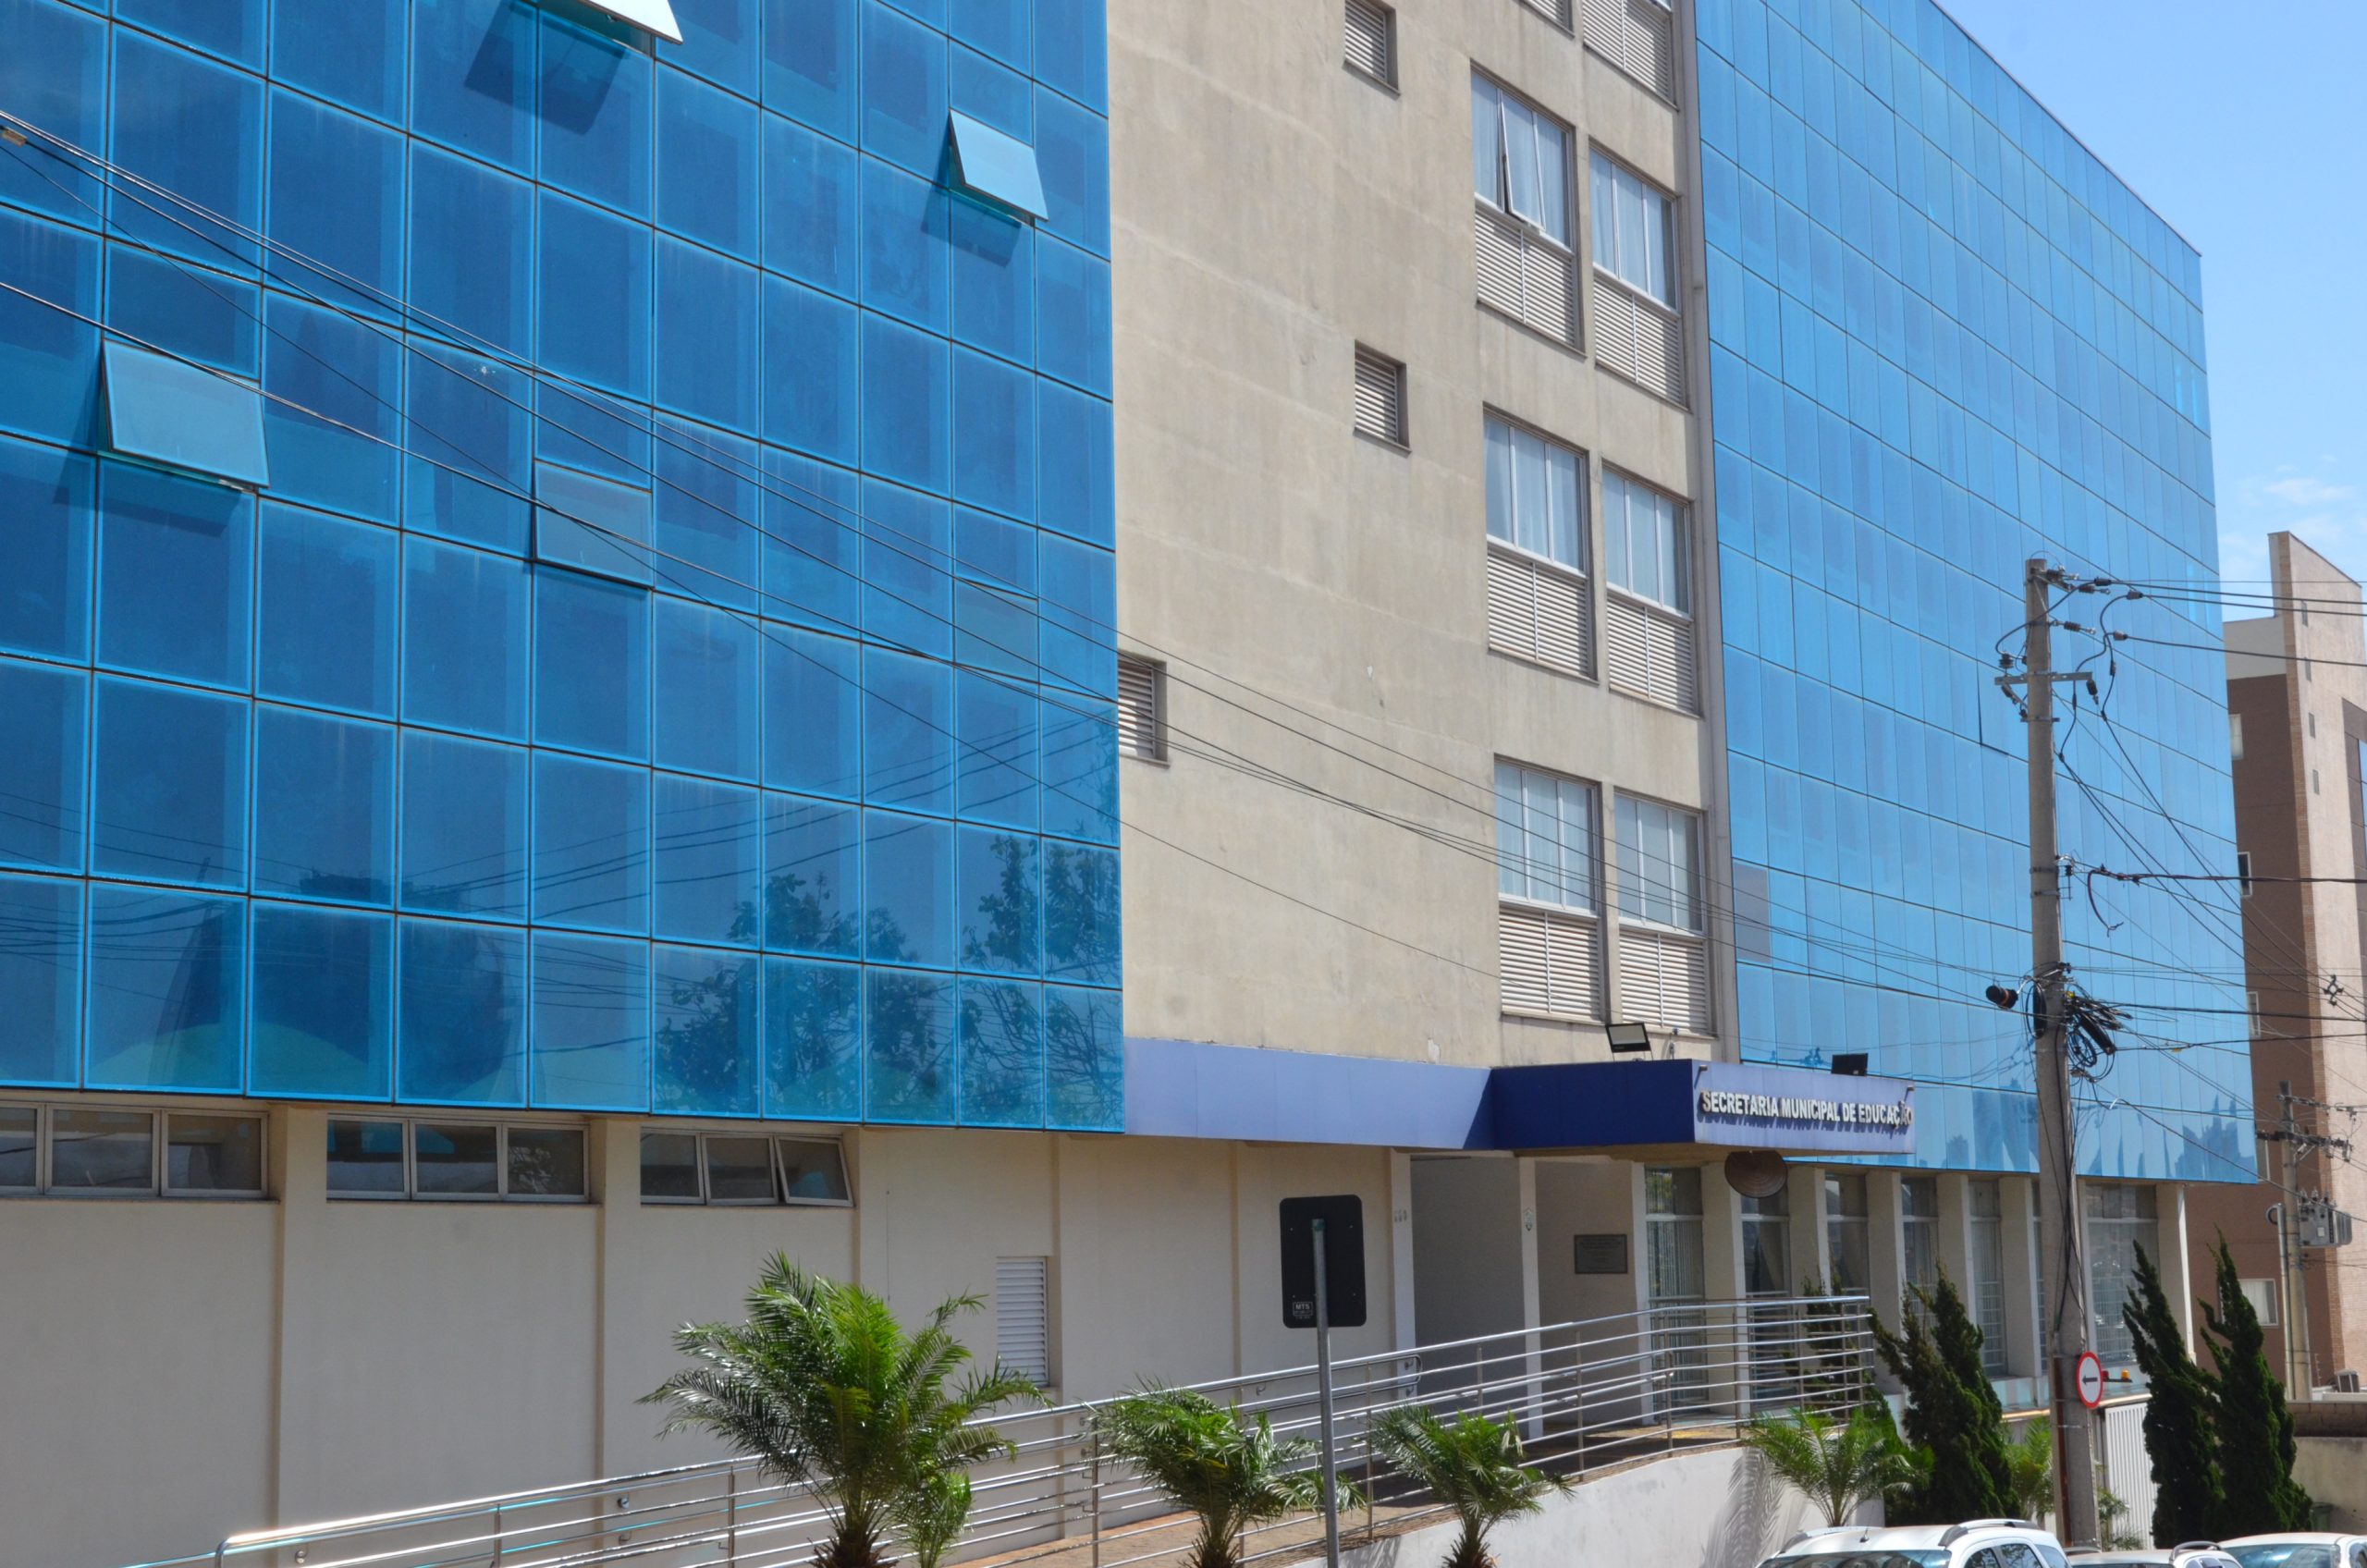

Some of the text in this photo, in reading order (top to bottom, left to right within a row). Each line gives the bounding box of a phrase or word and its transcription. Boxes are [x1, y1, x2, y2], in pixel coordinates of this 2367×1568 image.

[1701, 1091, 1779, 1118] SECRETARIA
[1781, 1097, 1840, 1121] MUNICIPAL
[1842, 1103, 1857, 1122] DE
